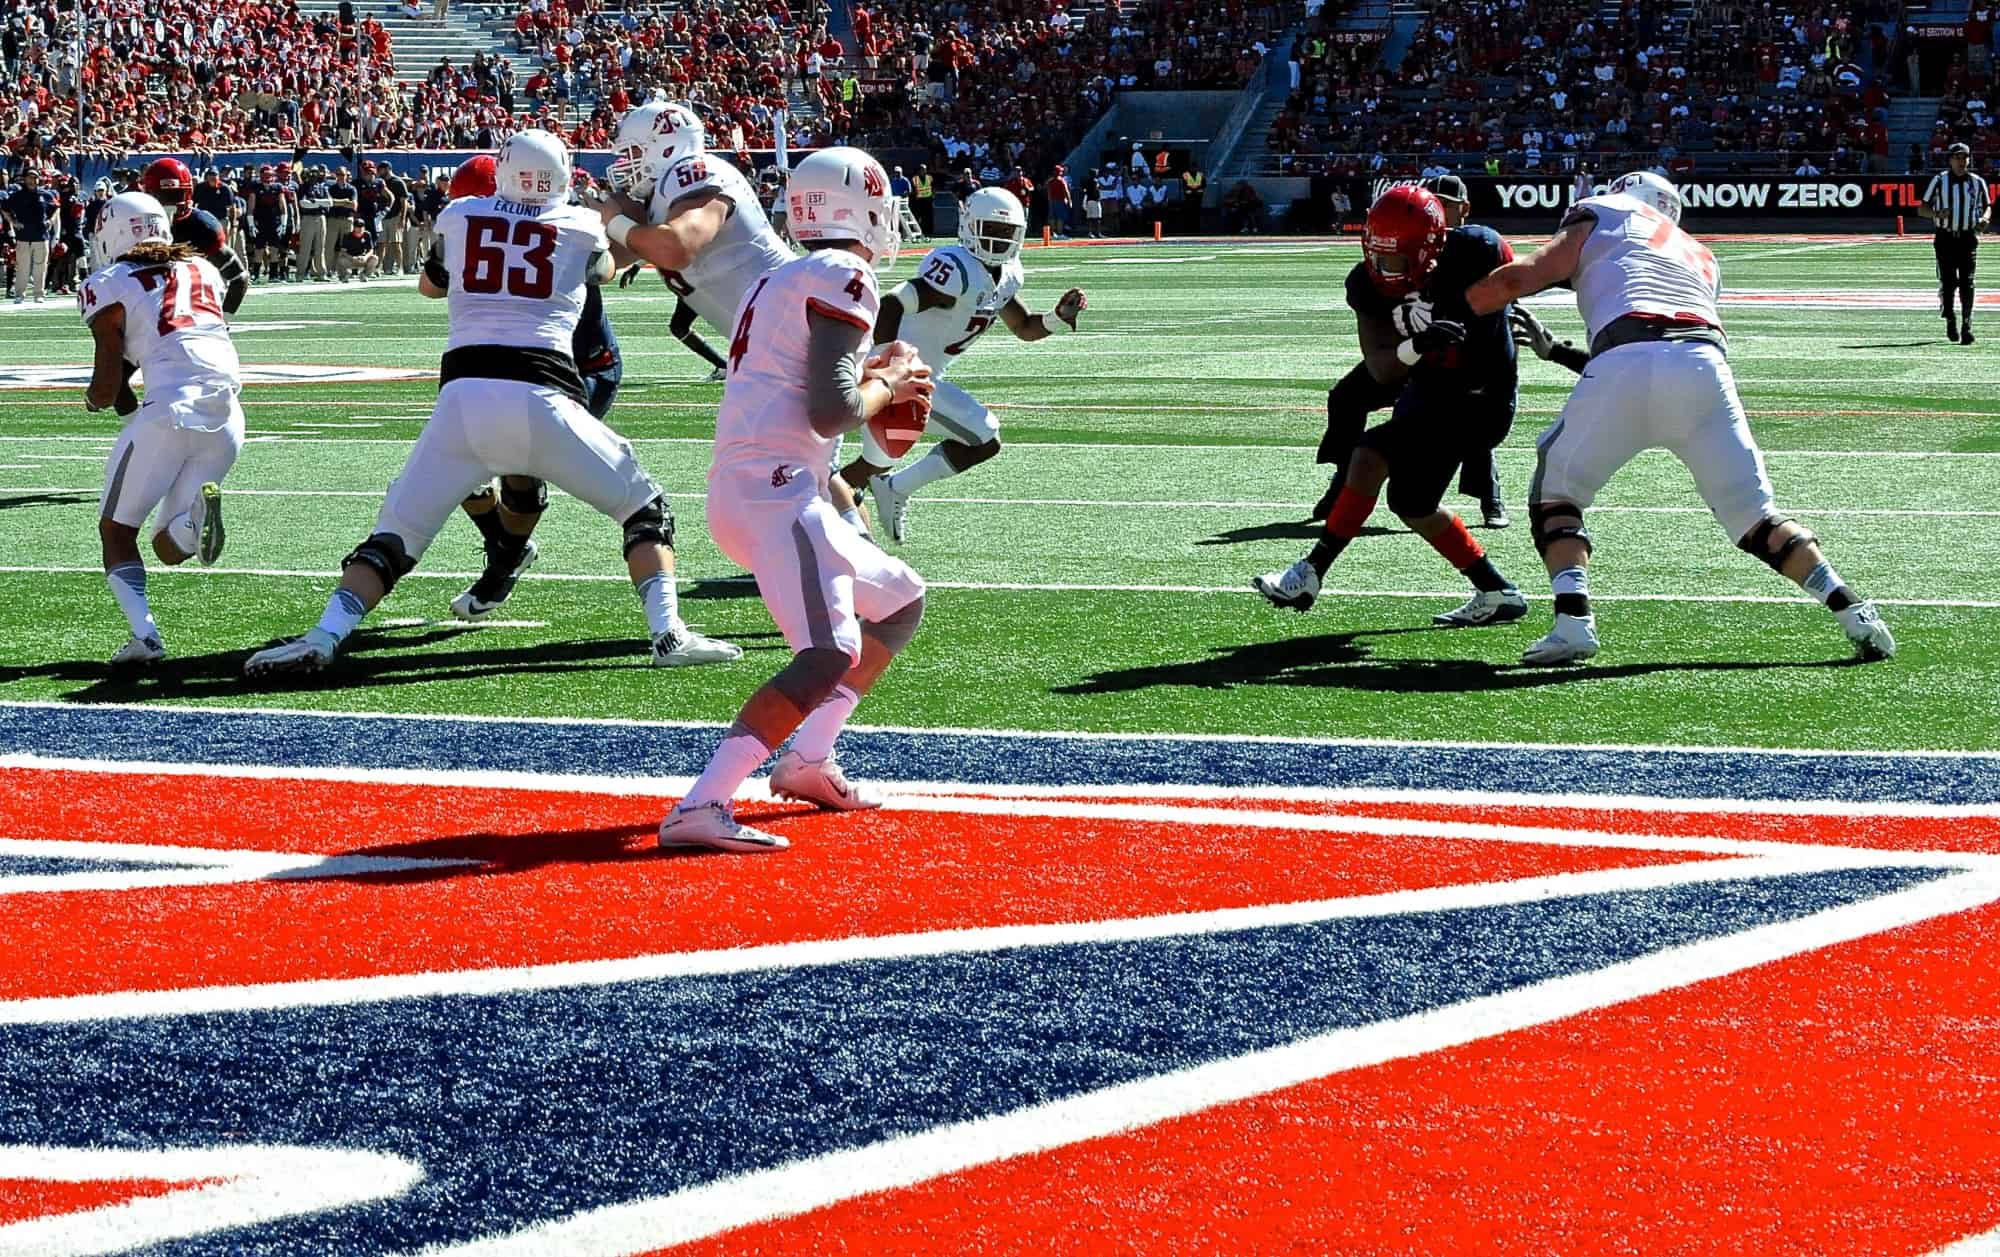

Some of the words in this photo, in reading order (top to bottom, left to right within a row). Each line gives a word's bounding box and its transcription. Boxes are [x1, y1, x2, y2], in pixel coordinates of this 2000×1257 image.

[1926, 27, 1956, 37] SECTION
[537, 180, 551, 192] 63
[1496, 183, 1561, 208] YOU
[1671, 183, 1770, 207] KNOW
[1778, 183, 1864, 207] ZERO
[1871, 183, 1923, 207] 'TIL
[494, 199, 542, 218] EKLUND
[808, 194, 822, 203] ESF
[807, 206, 817, 222] 4
[462, 214, 558, 300] 63
[923, 256, 955, 287] 25
[843, 269, 865, 303] 4
[128, 262, 224, 338] 24
[729, 276, 771, 375] 4
